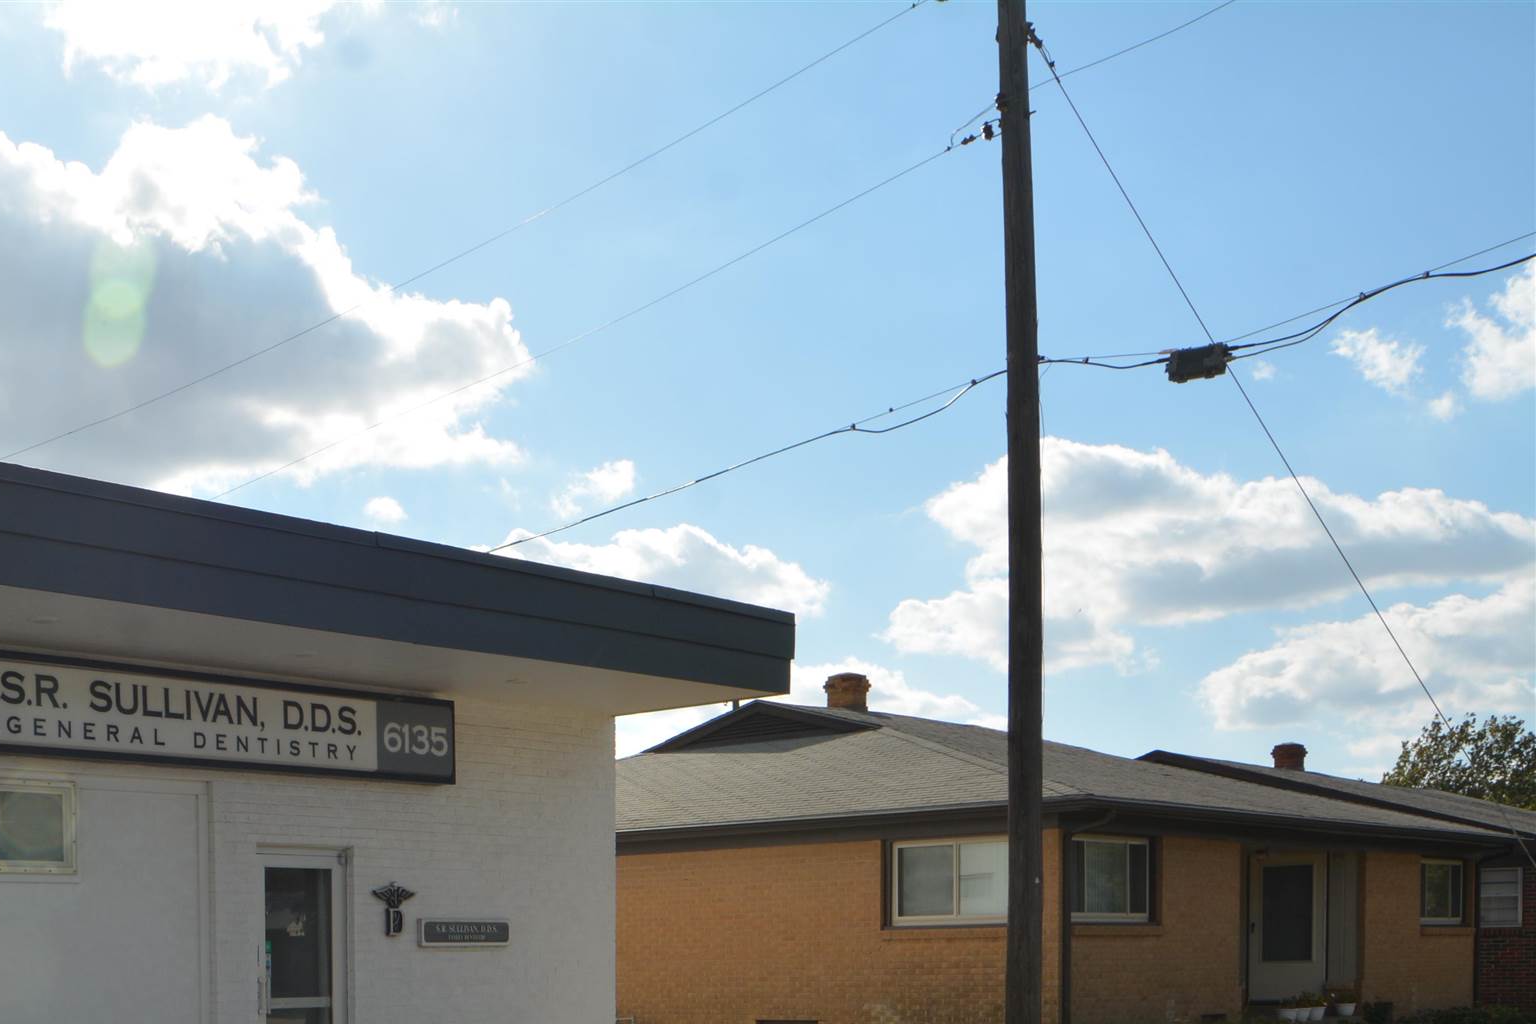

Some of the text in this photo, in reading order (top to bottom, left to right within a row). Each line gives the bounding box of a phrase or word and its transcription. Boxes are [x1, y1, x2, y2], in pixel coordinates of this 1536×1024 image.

[0, 670, 362, 737] S.R. SULLIVAN, D.D.S.
[6, 716, 359, 762] GENERAL DENTISTRY
[383, 721, 449, 757] 6135
